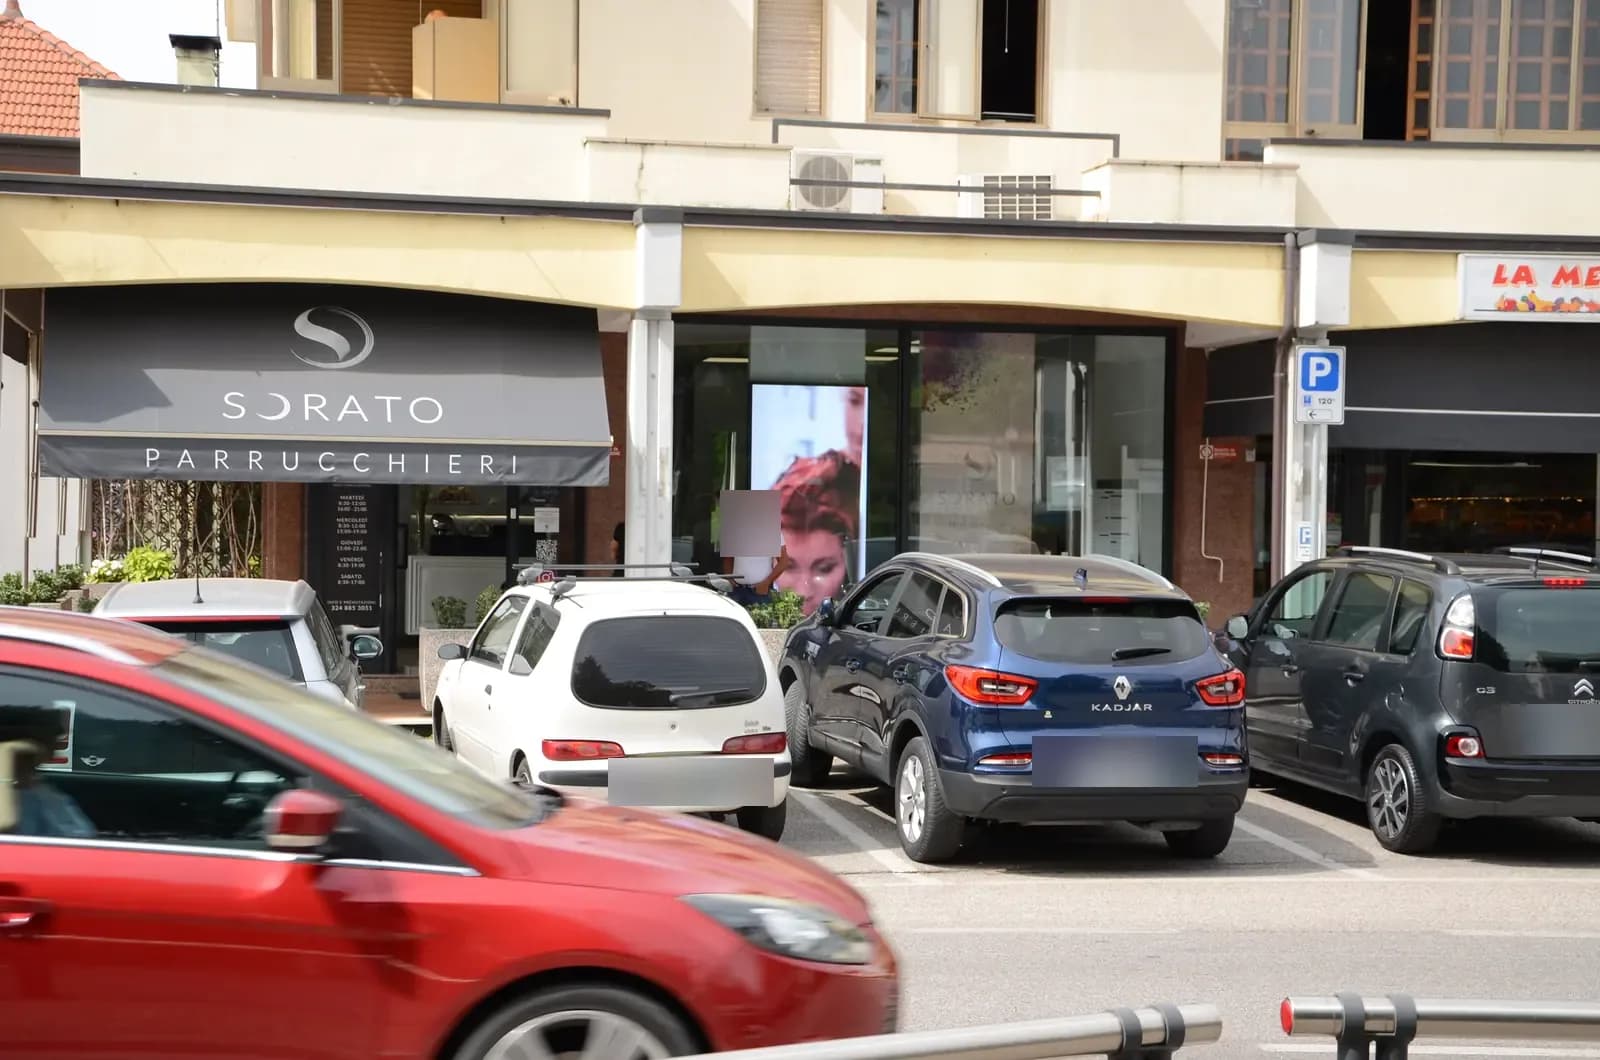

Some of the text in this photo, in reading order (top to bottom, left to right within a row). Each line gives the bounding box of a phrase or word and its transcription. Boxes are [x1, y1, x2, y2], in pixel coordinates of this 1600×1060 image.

[1492, 263, 1537, 287] LA
[1309, 356, 1332, 387] P
[222, 391, 444, 424] SORATO
[145, 448, 517, 474] PARRUCCHIERI
[1091, 703, 1153, 712] KADJAR
